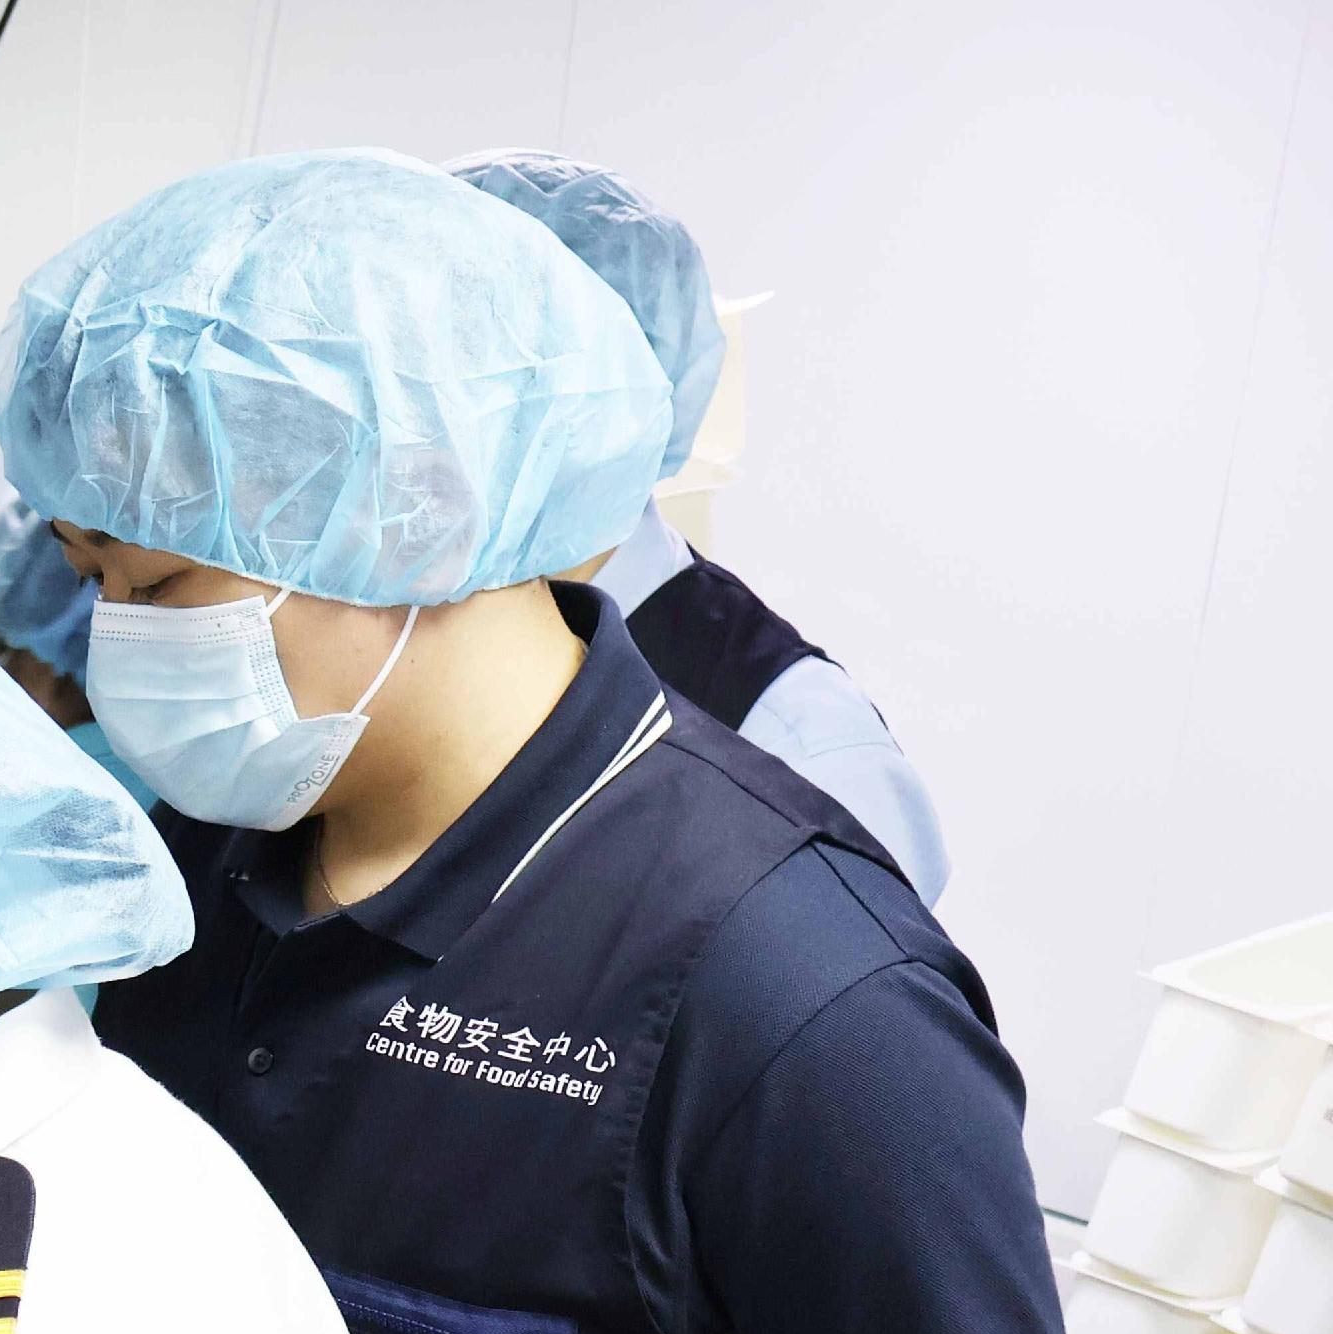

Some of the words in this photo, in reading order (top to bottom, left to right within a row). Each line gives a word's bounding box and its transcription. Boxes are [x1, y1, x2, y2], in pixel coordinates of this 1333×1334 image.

[365, 1032, 441, 1069] Centre
[442, 1052, 475, 1077] for
[474, 1060, 531, 1089] Food
[528, 1070, 604, 1106] Safety
[378, 995, 617, 1074] 食物安全中心
